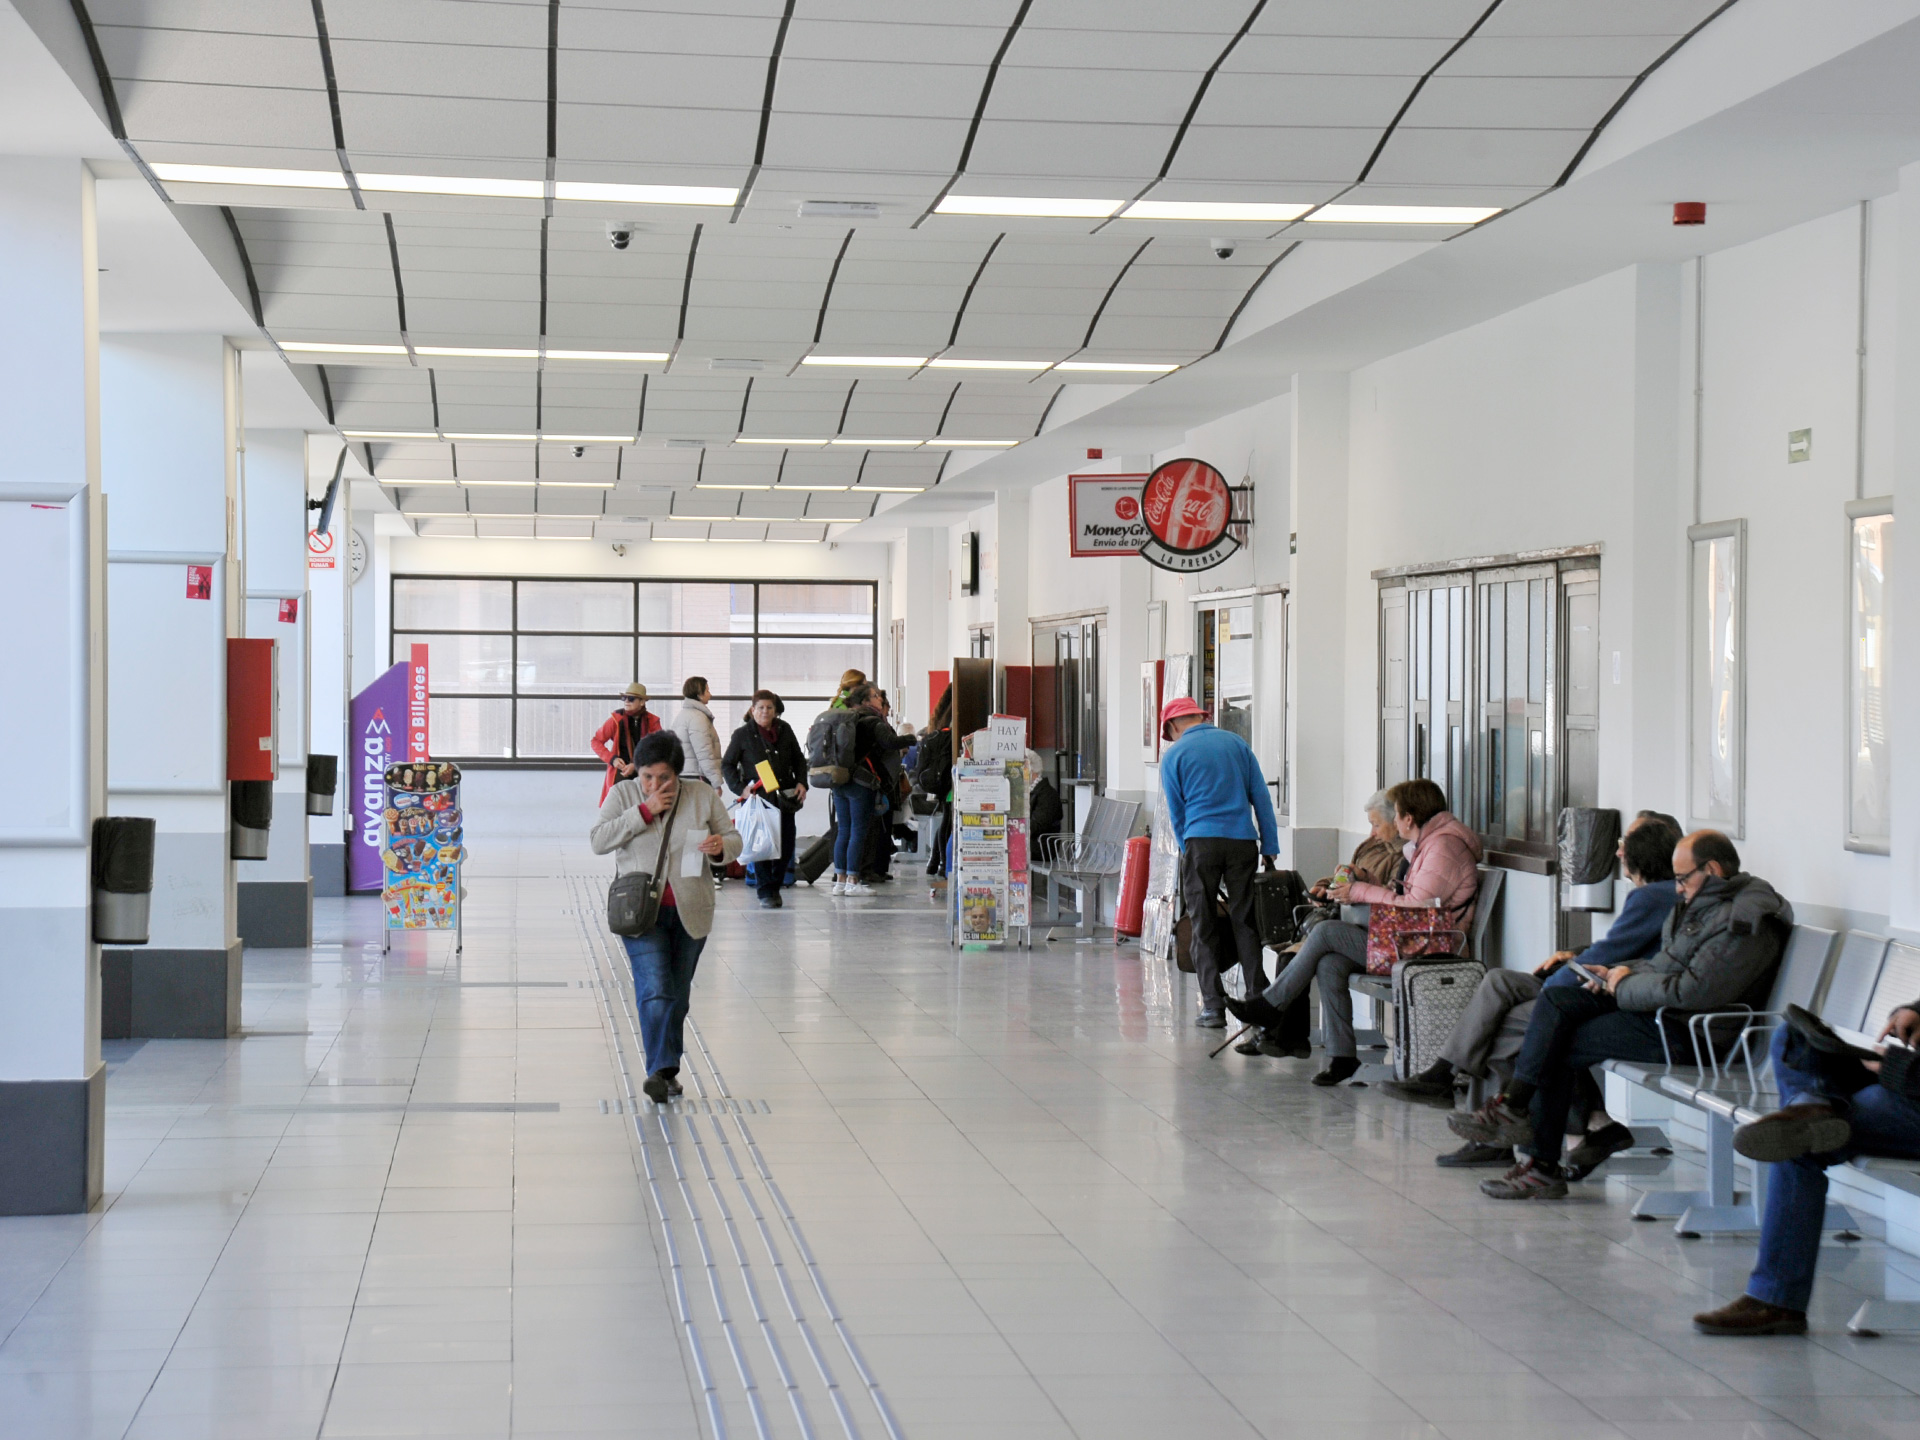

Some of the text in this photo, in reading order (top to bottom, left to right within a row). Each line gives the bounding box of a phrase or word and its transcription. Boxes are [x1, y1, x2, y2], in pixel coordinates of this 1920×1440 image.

[1146, 471, 1175, 526] Coca-Cola
[1083, 523, 1149, 538] MoneyGr
[1118, 538, 1129, 547] de
[1160, 549, 1222, 568] LA PRENSA
[411, 666, 426, 728] Billetes
[997, 726, 1019, 736] HAY
[411, 731, 426, 753] de
[997, 742, 1018, 751] PAN
[363, 736, 384, 847] avanza
